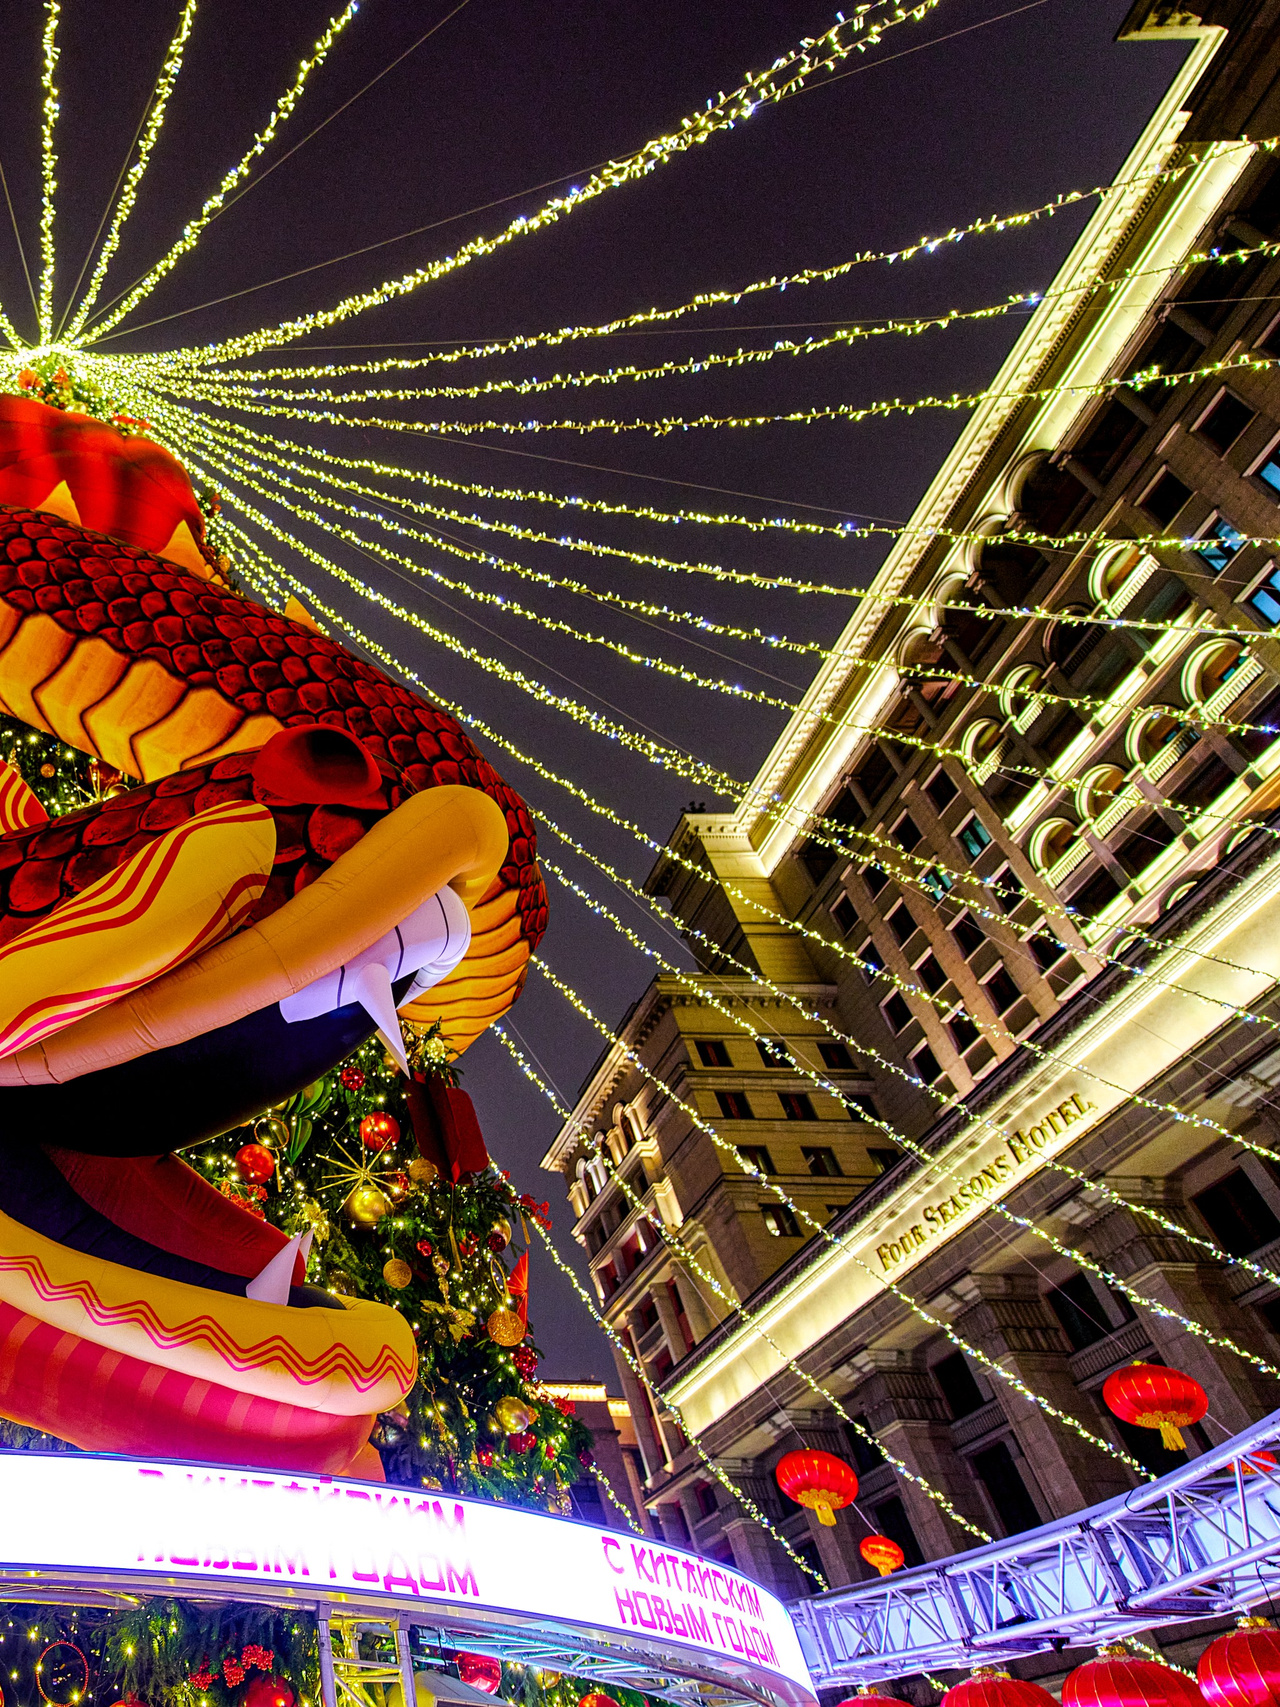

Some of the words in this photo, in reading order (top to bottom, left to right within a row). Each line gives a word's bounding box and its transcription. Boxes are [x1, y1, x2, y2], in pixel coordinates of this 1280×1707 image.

[875, 1224, 929, 1273] FOUR
[923, 1154, 1014, 1235] SEASONS
[1007, 1093, 1097, 1166] HOTEL
[601, 1536, 625, 1574] С
[630, 1543, 765, 1622] КИТАЙСКИМ
[613, 1586, 714, 1645] НОВЫМ
[712, 1612, 781, 1668] ГОДОМ
